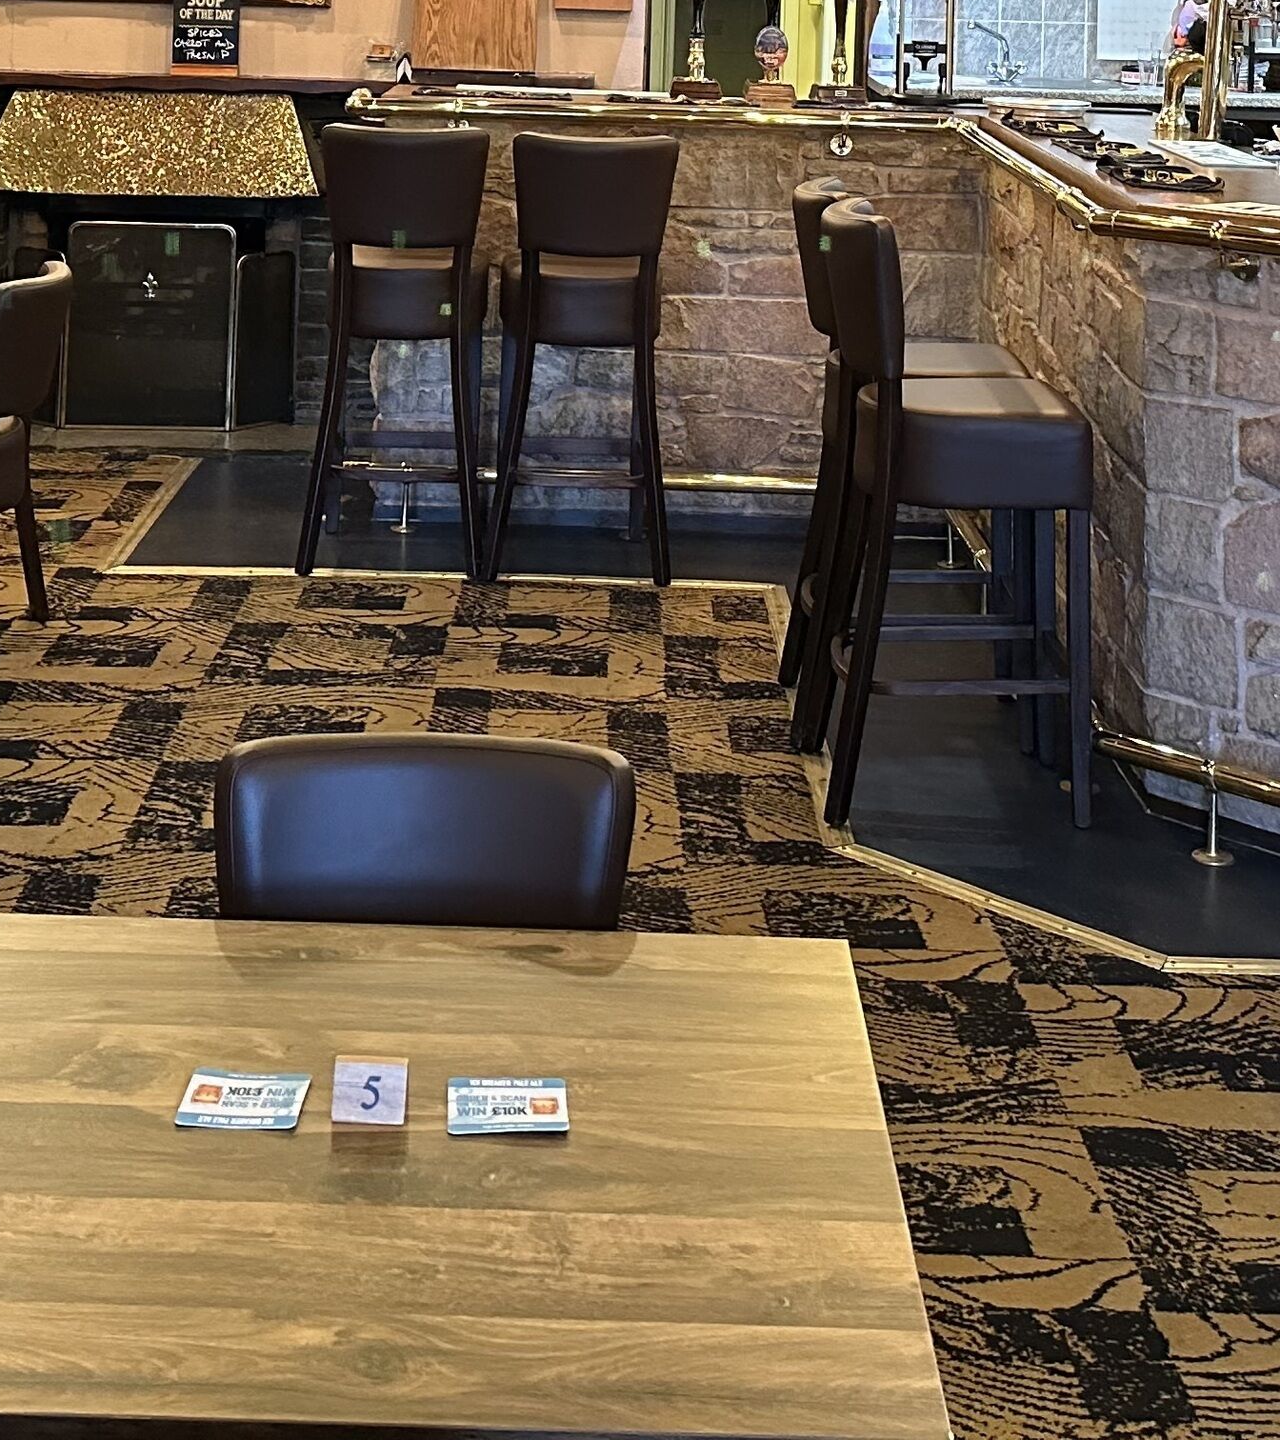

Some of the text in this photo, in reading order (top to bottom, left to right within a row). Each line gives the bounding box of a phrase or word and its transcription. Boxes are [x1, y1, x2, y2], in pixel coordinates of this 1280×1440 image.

[180, 8, 235, 21] OF THE DAY
[227, 1086, 264, 1097] £10K
[360, 1075, 382, 1111] 5
[457, 1106, 528, 1117] WIN £10K
